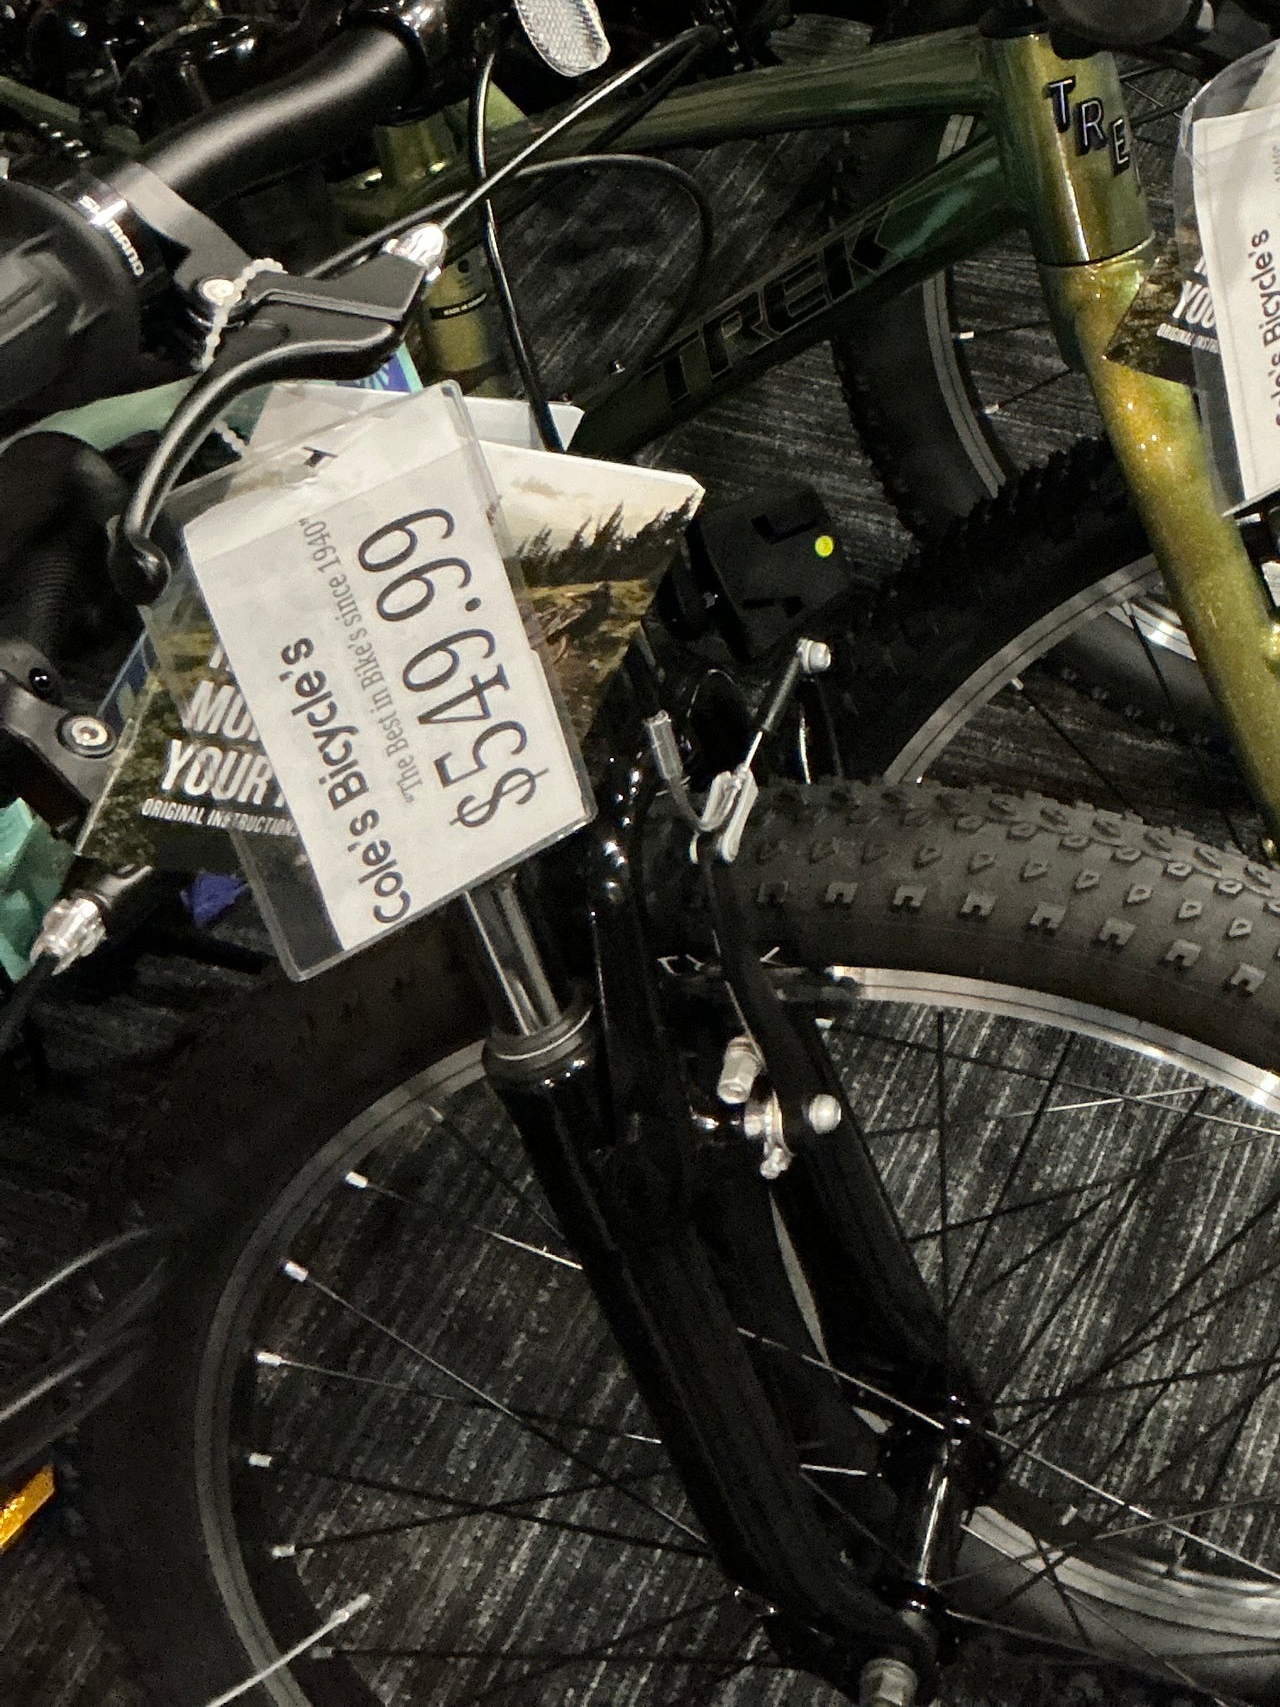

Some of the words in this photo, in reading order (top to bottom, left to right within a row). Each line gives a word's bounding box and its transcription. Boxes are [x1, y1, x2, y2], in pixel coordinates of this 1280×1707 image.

[1042, 75, 1136, 184] TRE
[642, 199, 905, 410] TREK
[328, 572, 363, 630] since
[348, 629, 383, 694] Bike's
[358, 508, 550, 829] $549.99
[279, 637, 370, 810] Bicycle's
[369, 699, 390, 722] in
[376, 718, 412, 768] Best
[160, 737, 275, 805] YOUR
[141, 797, 204, 827] ORIGINAL
[347, 808, 411, 925] Cole's
